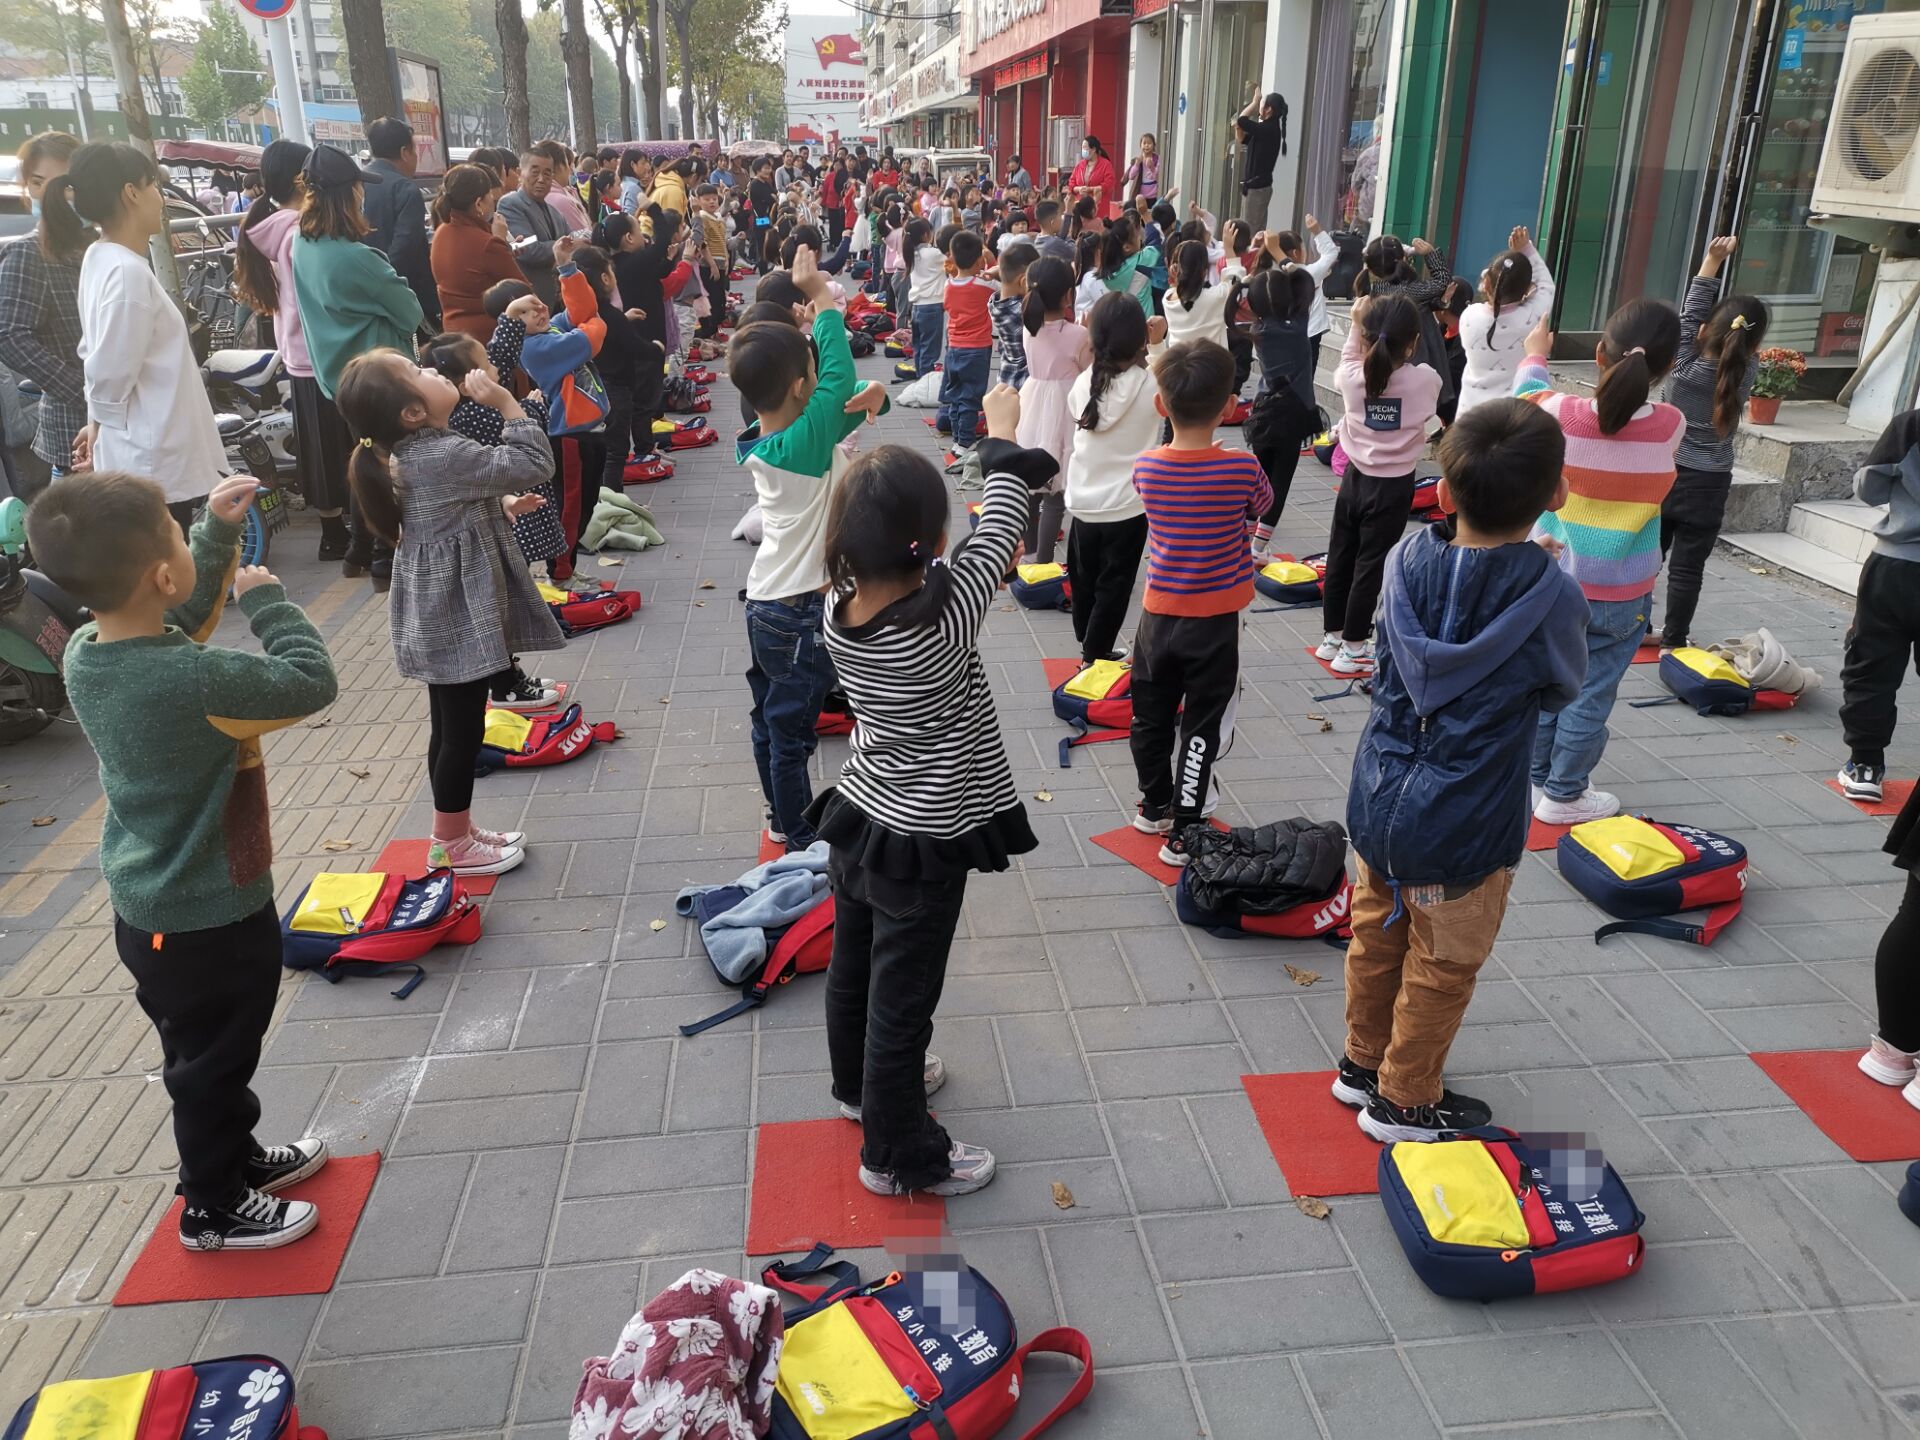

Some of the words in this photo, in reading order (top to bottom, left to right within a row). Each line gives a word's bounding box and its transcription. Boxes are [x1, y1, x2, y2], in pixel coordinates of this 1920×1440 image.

[1367, 404, 1399, 413] SPECIAL
[1371, 413, 1396, 422] MOVIE
[1180, 735, 1207, 807] CHINA
[1530, 1166, 1576, 1234] 幼小衔接
[1574, 1193, 1620, 1236] 立教育
[895, 1305, 955, 1374] 幼小衔接
